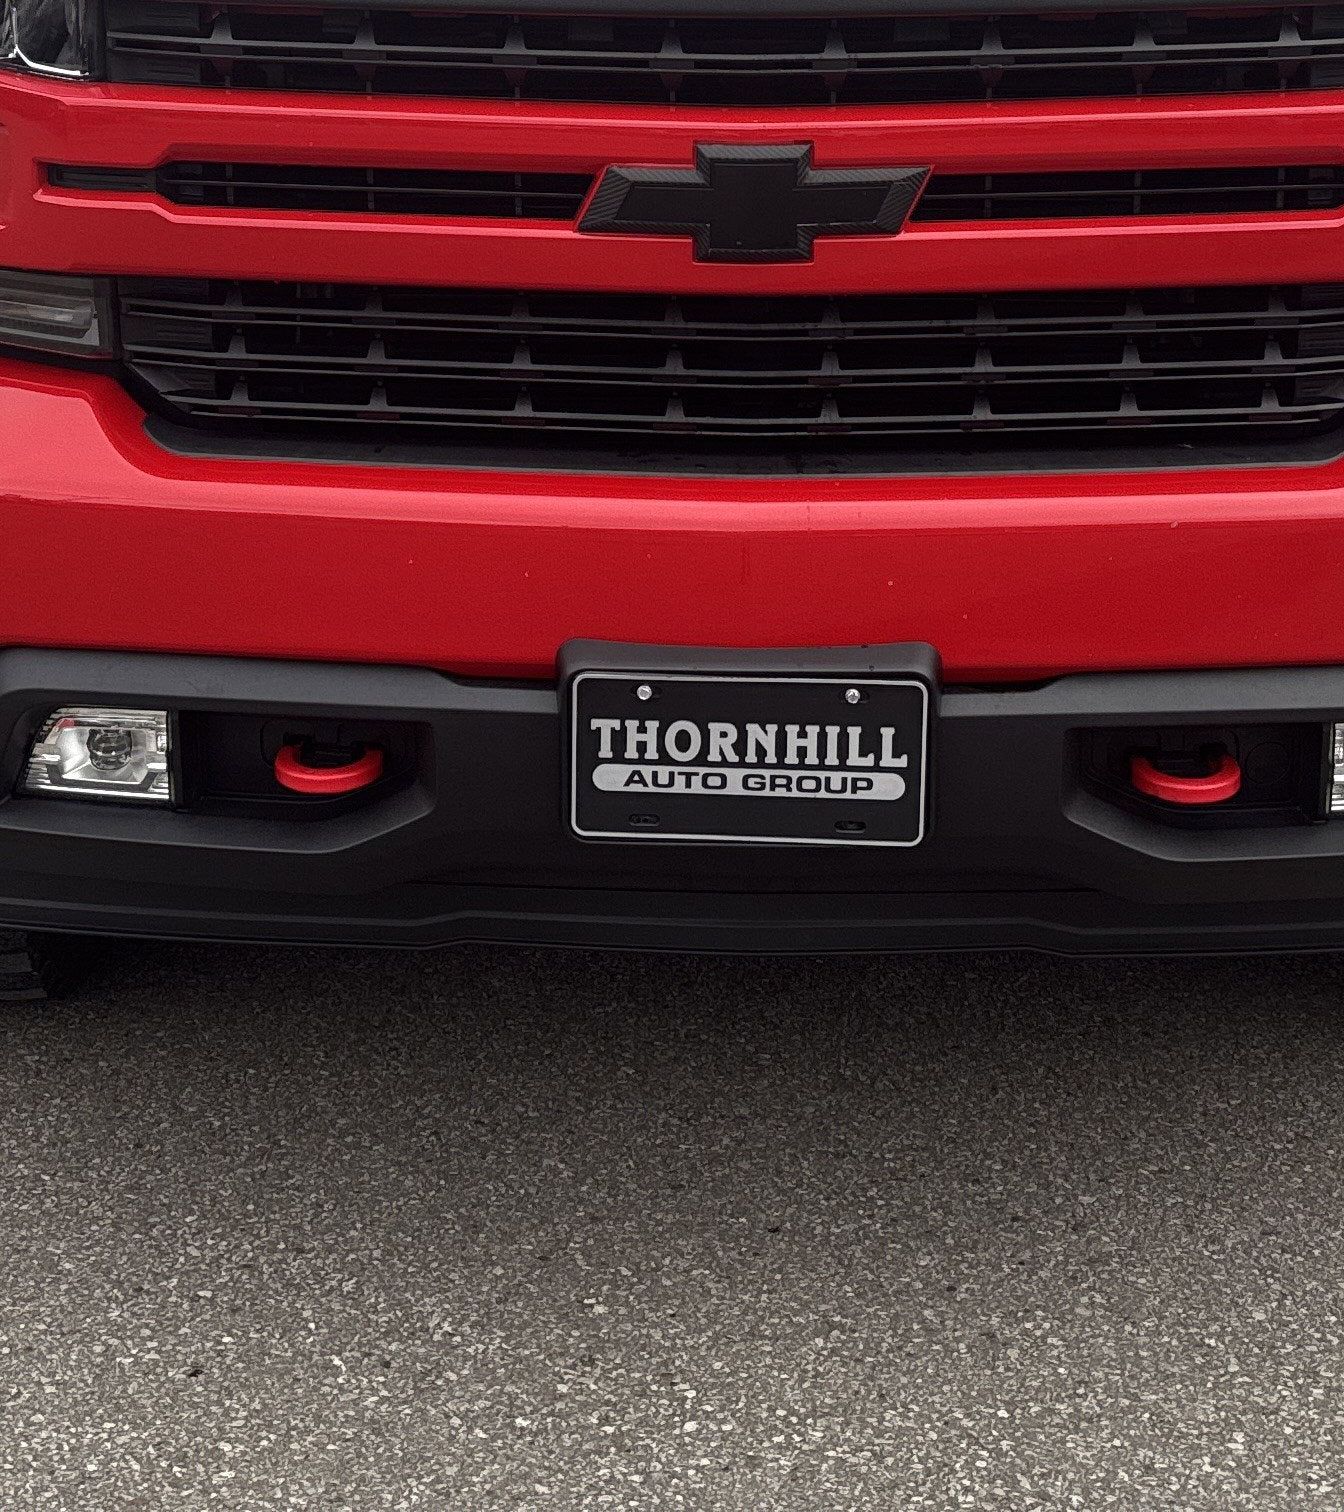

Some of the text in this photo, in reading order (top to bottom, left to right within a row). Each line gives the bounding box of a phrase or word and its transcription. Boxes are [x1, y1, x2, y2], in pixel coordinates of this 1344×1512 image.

[590, 718, 908, 768] THORNHILL
[623, 769, 874, 795] AUTO GROUP
